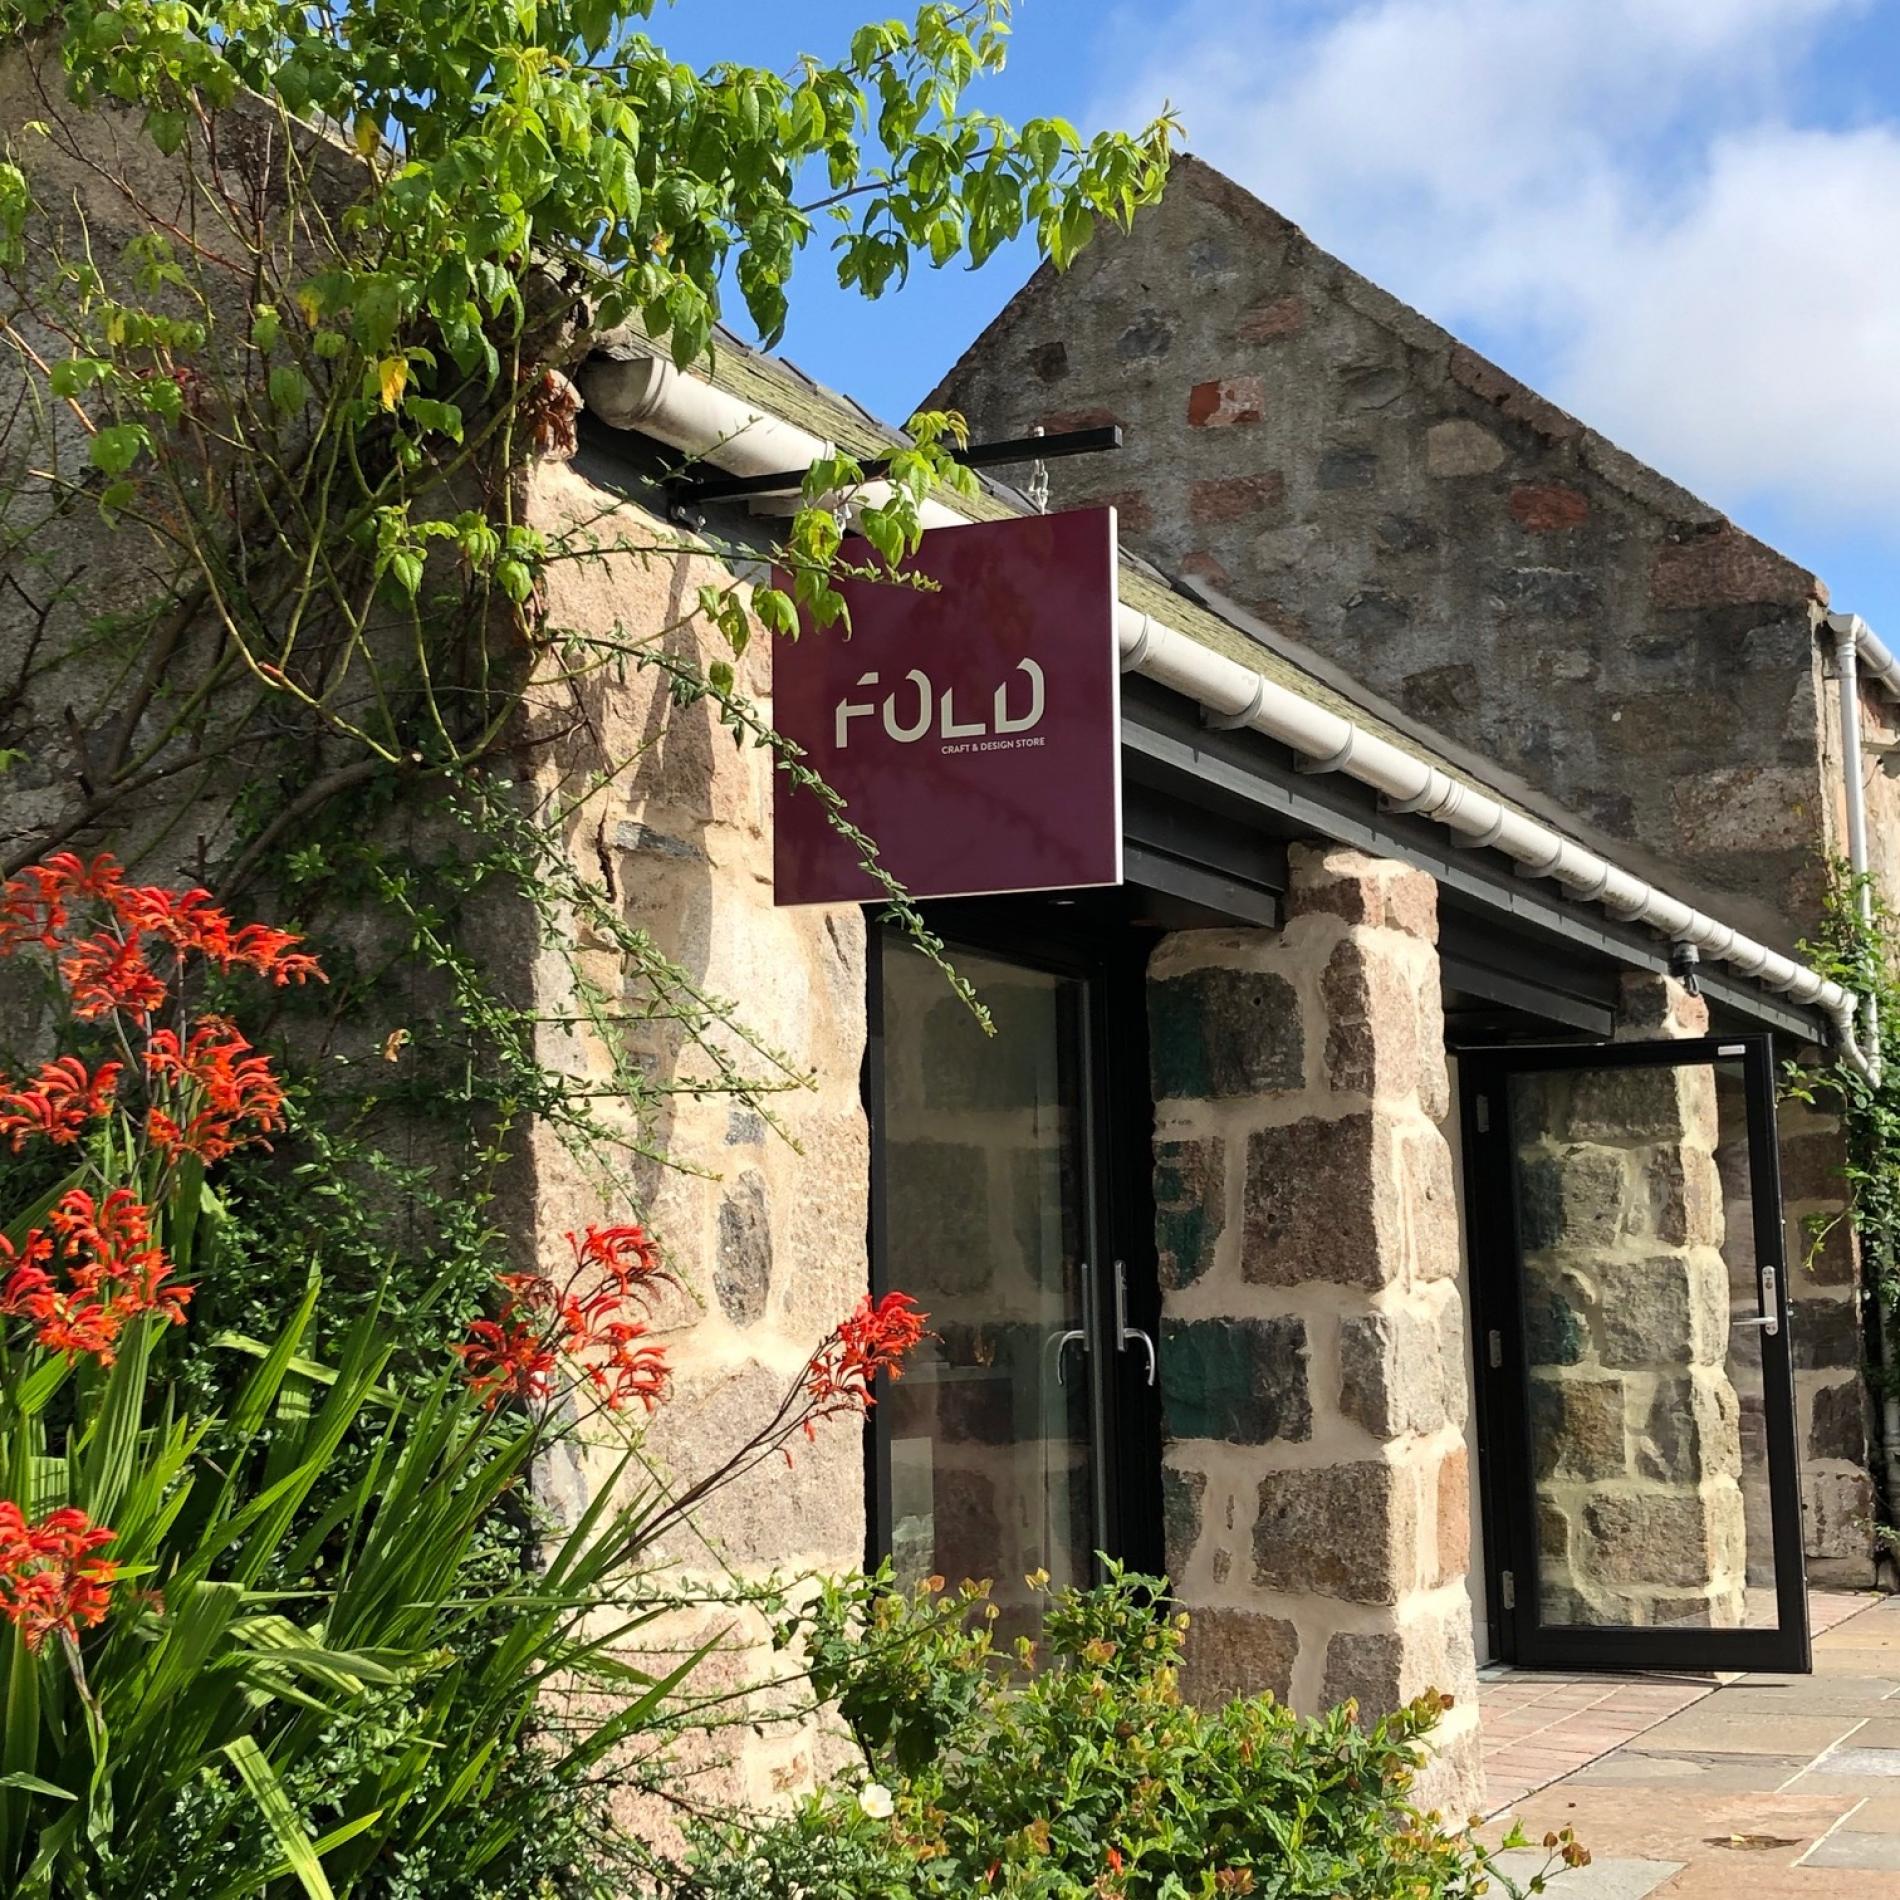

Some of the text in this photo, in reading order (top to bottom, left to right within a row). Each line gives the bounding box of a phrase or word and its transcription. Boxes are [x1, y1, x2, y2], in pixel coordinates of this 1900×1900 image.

[836, 657, 1045, 748] FOLD
[941, 737, 1046, 755] CRAFT & DESIGN STORE
